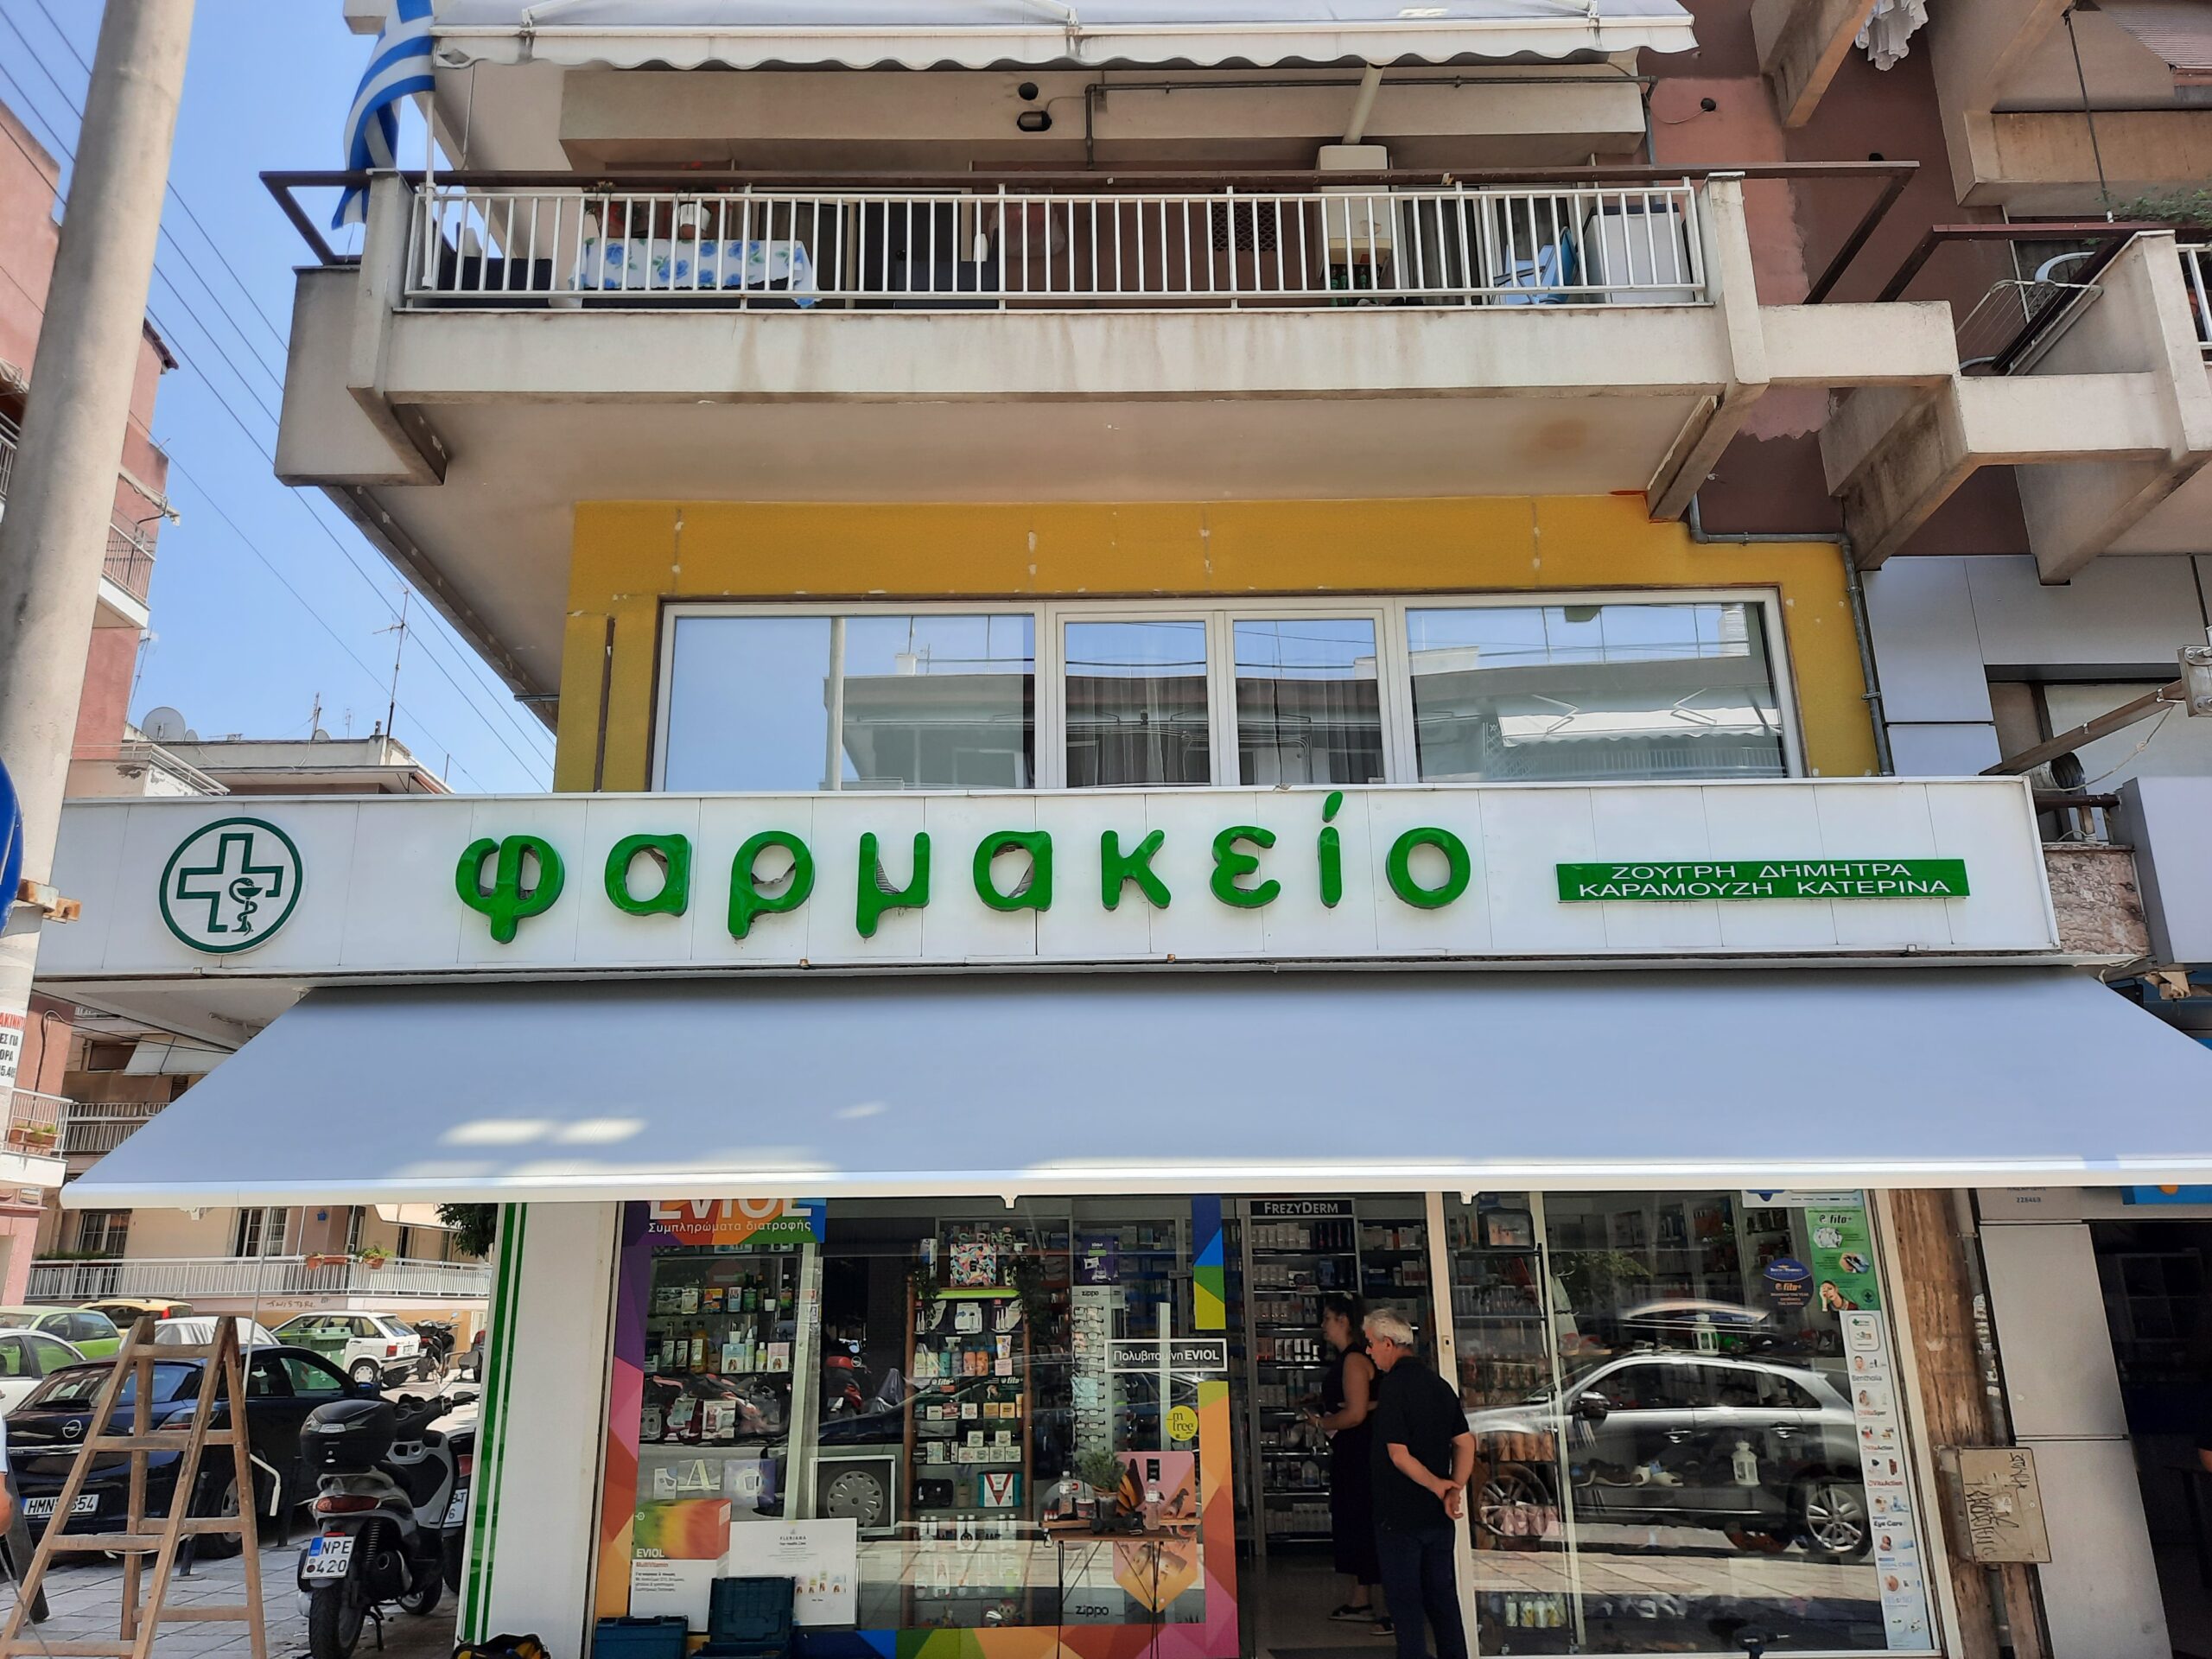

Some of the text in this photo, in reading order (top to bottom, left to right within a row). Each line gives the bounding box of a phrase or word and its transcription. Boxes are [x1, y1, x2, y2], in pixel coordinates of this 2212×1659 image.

[455, 791, 1471, 944] φαρμακείο
[1611, 863, 1911, 880] ΖΟΥΓΡΗ ΔΗΜΗΤΡΑ
[1580, 880, 1951, 897] ΚΑΡΑΜΟΥΖΗ ΚΑΤΕΡΙΝΑ
[1264, 1202, 1338, 1214] FREZYDERM
[648, 1220, 811, 1234] Συμπληρώματα διατροφής
[1185, 1350, 1220, 1360] EVIOL
[321, 1540, 352, 1555] NPE
[636, 1548, 665, 1558] EVIOL
[317, 1559, 347, 1573] 420
[1076, 1605, 1109, 1618] zippo
